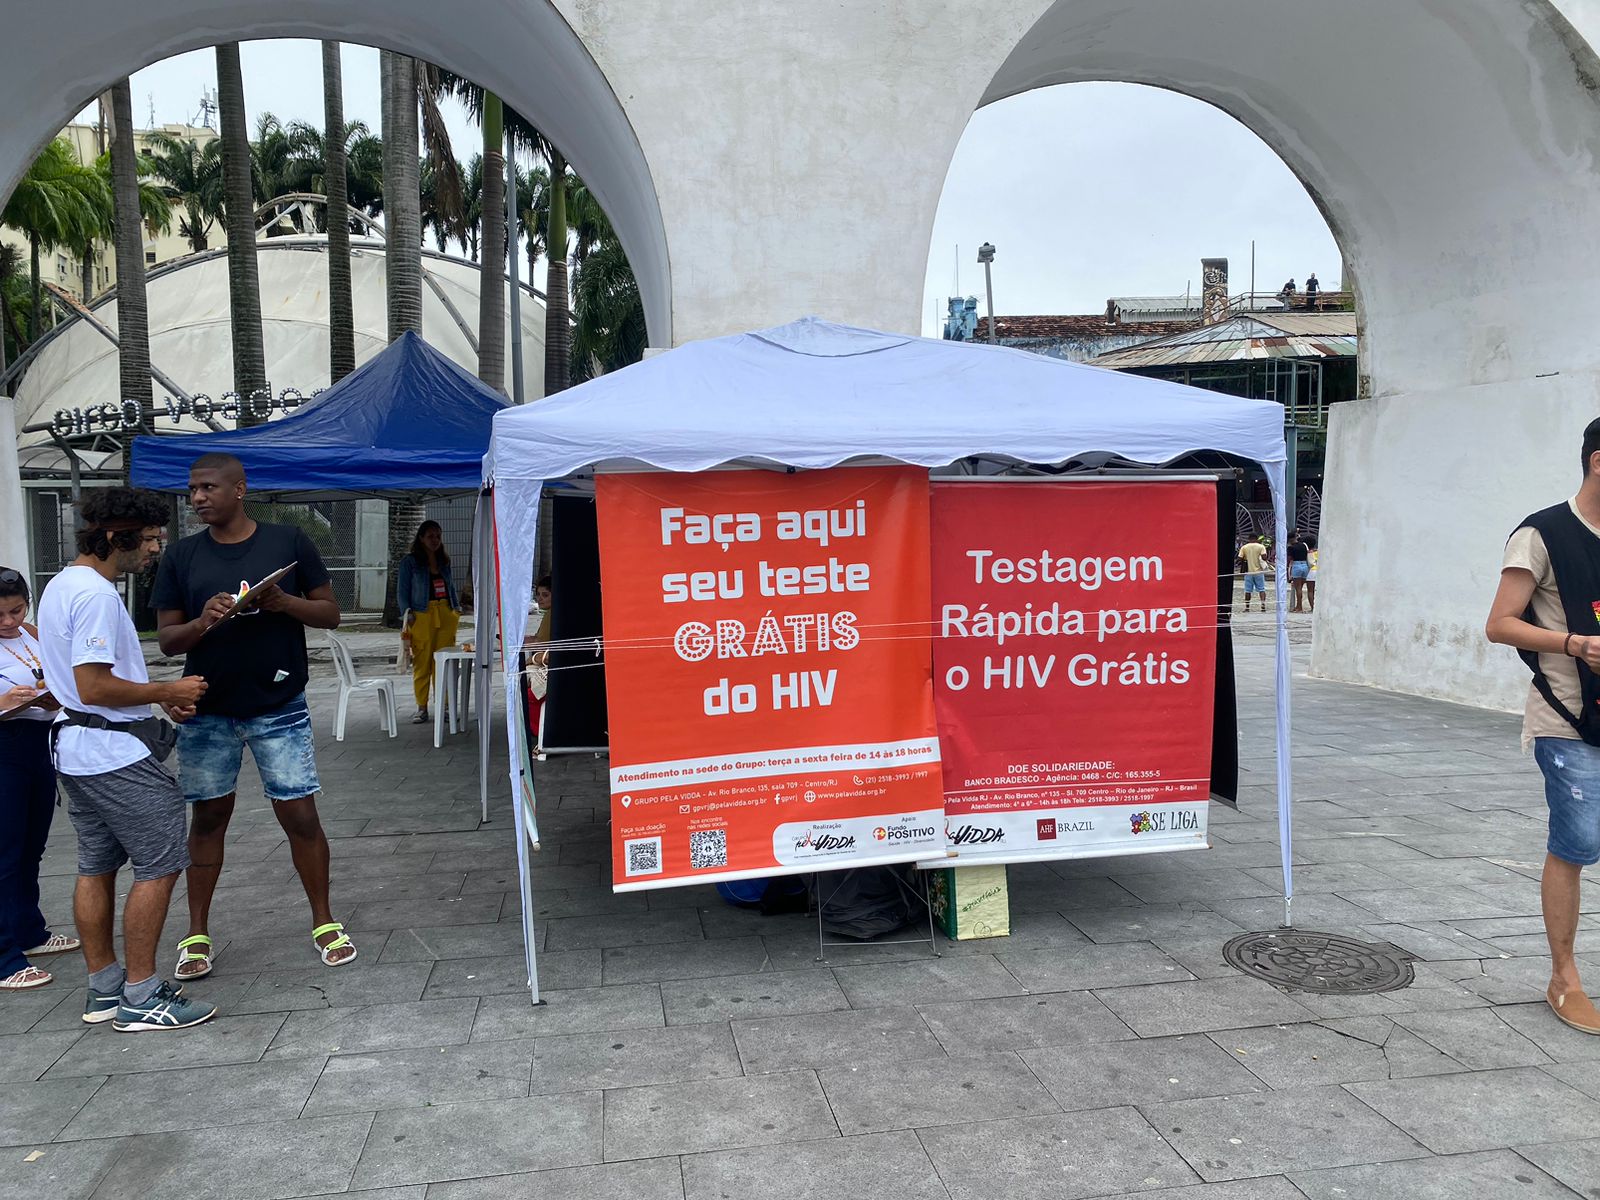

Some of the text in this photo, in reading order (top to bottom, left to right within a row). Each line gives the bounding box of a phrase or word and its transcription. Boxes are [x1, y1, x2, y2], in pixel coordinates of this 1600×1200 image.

[661, 500, 866, 552] Faça aqui
[662, 557, 870, 603] seu teste
[966, 550, 1163, 590] Testagem
[674, 610, 860, 662] GRÁTIS
[942, 602, 1188, 645] Rápida para
[946, 652, 1190, 690] o HIV Grátis
[704, 669, 837, 716] do HIV
[618, 769, 679, 782] Atendimento
[696, 766, 719, 774] sede
[736, 761, 766, 771] Grupo:
[768, 758, 791, 767] terça
[831, 752, 852, 761] feira
[855, 752, 866, 760] de
[883, 749, 893, 758] às
[895, 748, 905, 756] 18
[907, 746, 932, 755] horas
[965, 777, 992, 787] BANCO
[994, 775, 1039, 785] BRADESCO
[1045, 773, 1079, 784] Agência:
[1125, 770, 1160, 778] 165.355-5
[1008, 761, 1115, 774] DOE SOLIDARIEDADE:
[635, 797, 659, 805] GRUPO
[660, 794, 678, 802] PELA
[680, 792, 701, 800] VIDDA
[888, 827, 935, 840] POSITIVO
[1040, 821, 1094, 834] AHF BRAZIL
[1151, 812, 1166, 831] SE
